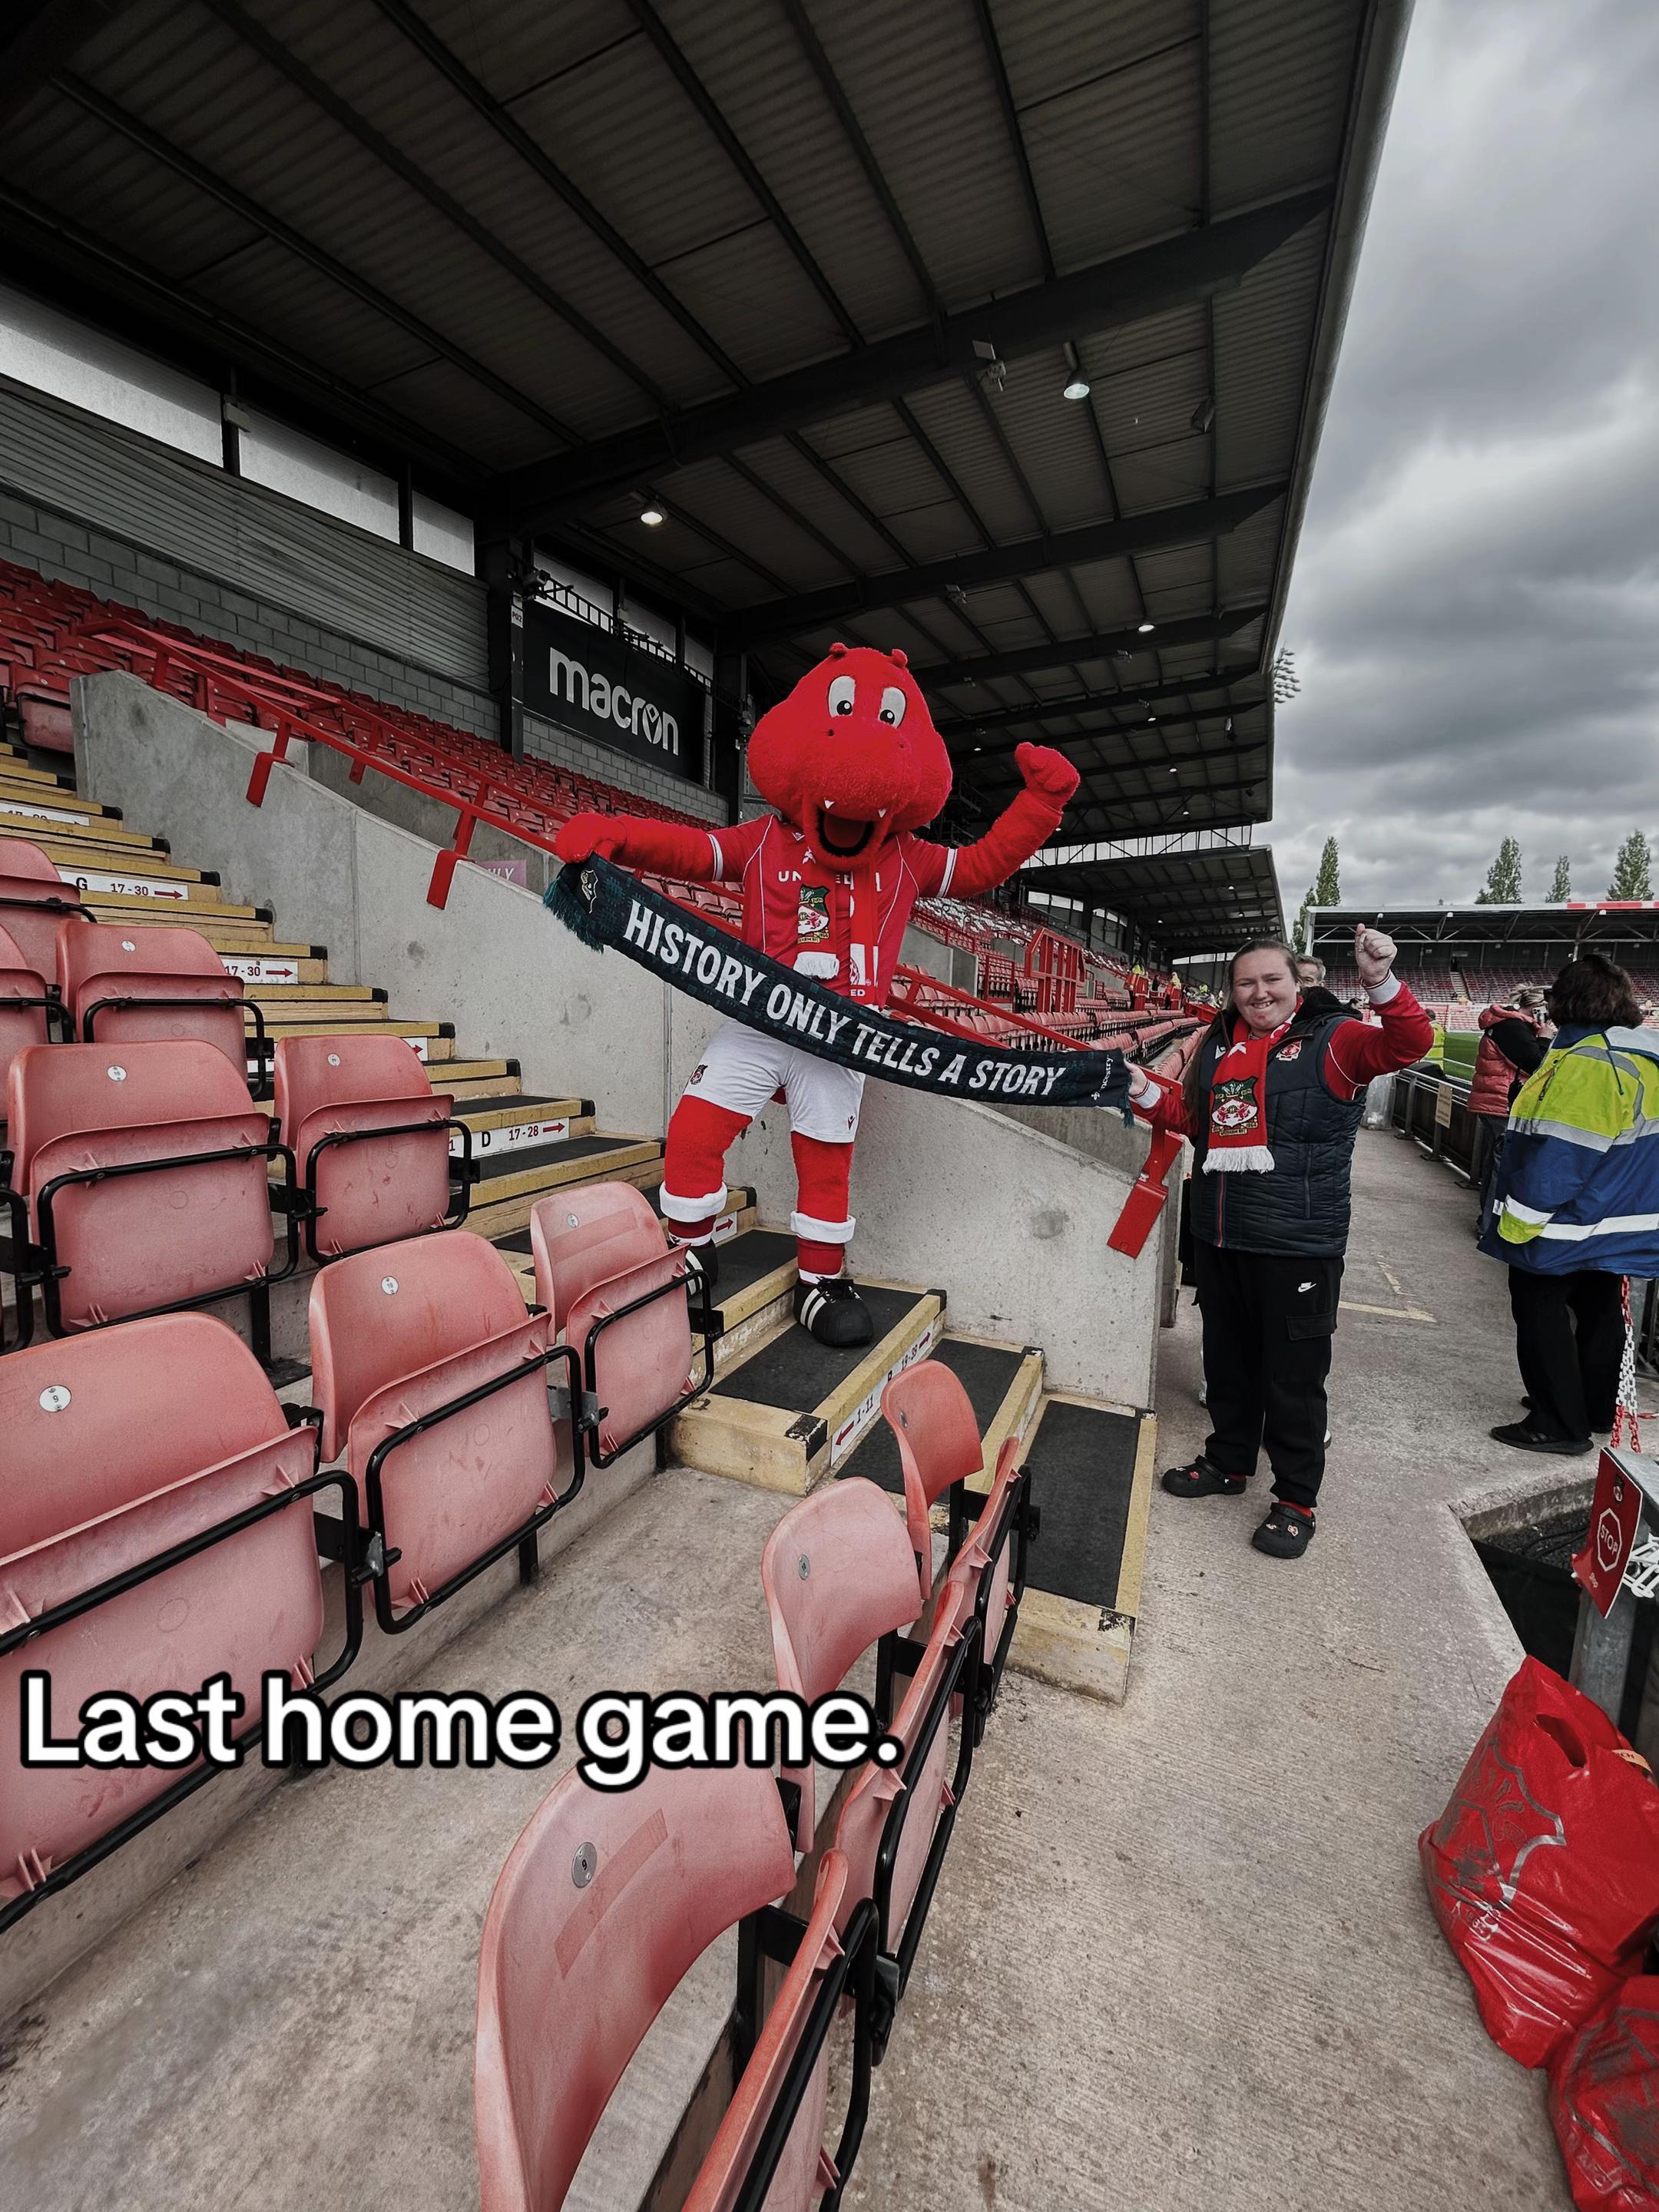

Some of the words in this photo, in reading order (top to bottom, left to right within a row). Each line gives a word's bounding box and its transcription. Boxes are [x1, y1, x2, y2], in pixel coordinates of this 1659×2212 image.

[549, 647, 679, 756] macron
[75, 877, 88, 891] G
[622, 899, 767, 1007] HISTORY
[766, 983, 853, 1045] ONLY
[851, 1022, 940, 1077] TELLS
[937, 1053, 968, 1084] A
[968, 1059, 1067, 1096] STORY
[1100, 1056, 1114, 1091] ncestry
[481, 1131, 491, 1148] D
[508, 1125, 539, 1141] 17-28
[1600, 1524, 1618, 1555] STOP
